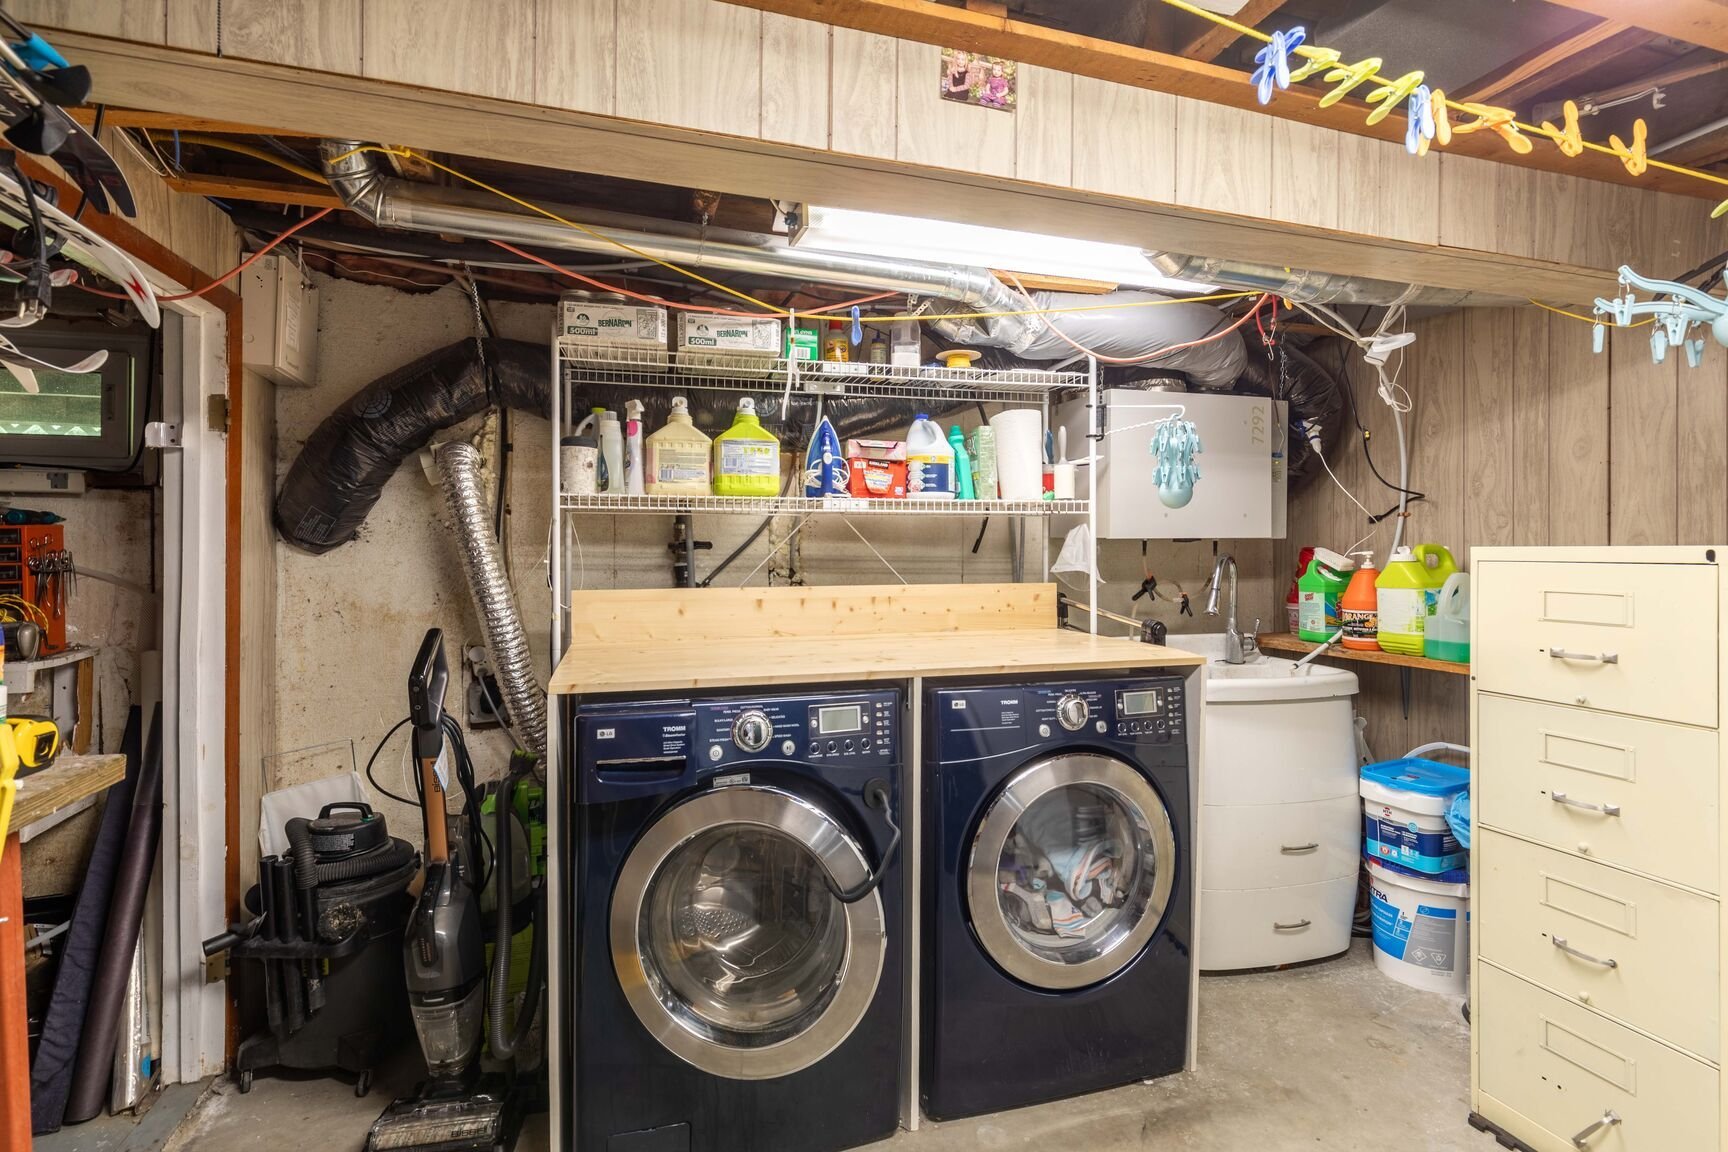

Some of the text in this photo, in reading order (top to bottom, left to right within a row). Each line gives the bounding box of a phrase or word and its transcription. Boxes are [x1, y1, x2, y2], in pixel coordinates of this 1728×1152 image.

[569, 326, 596, 336] 500ml
[690, 337, 715, 346] 500ml
[1252, 406, 1265, 445] 7292
